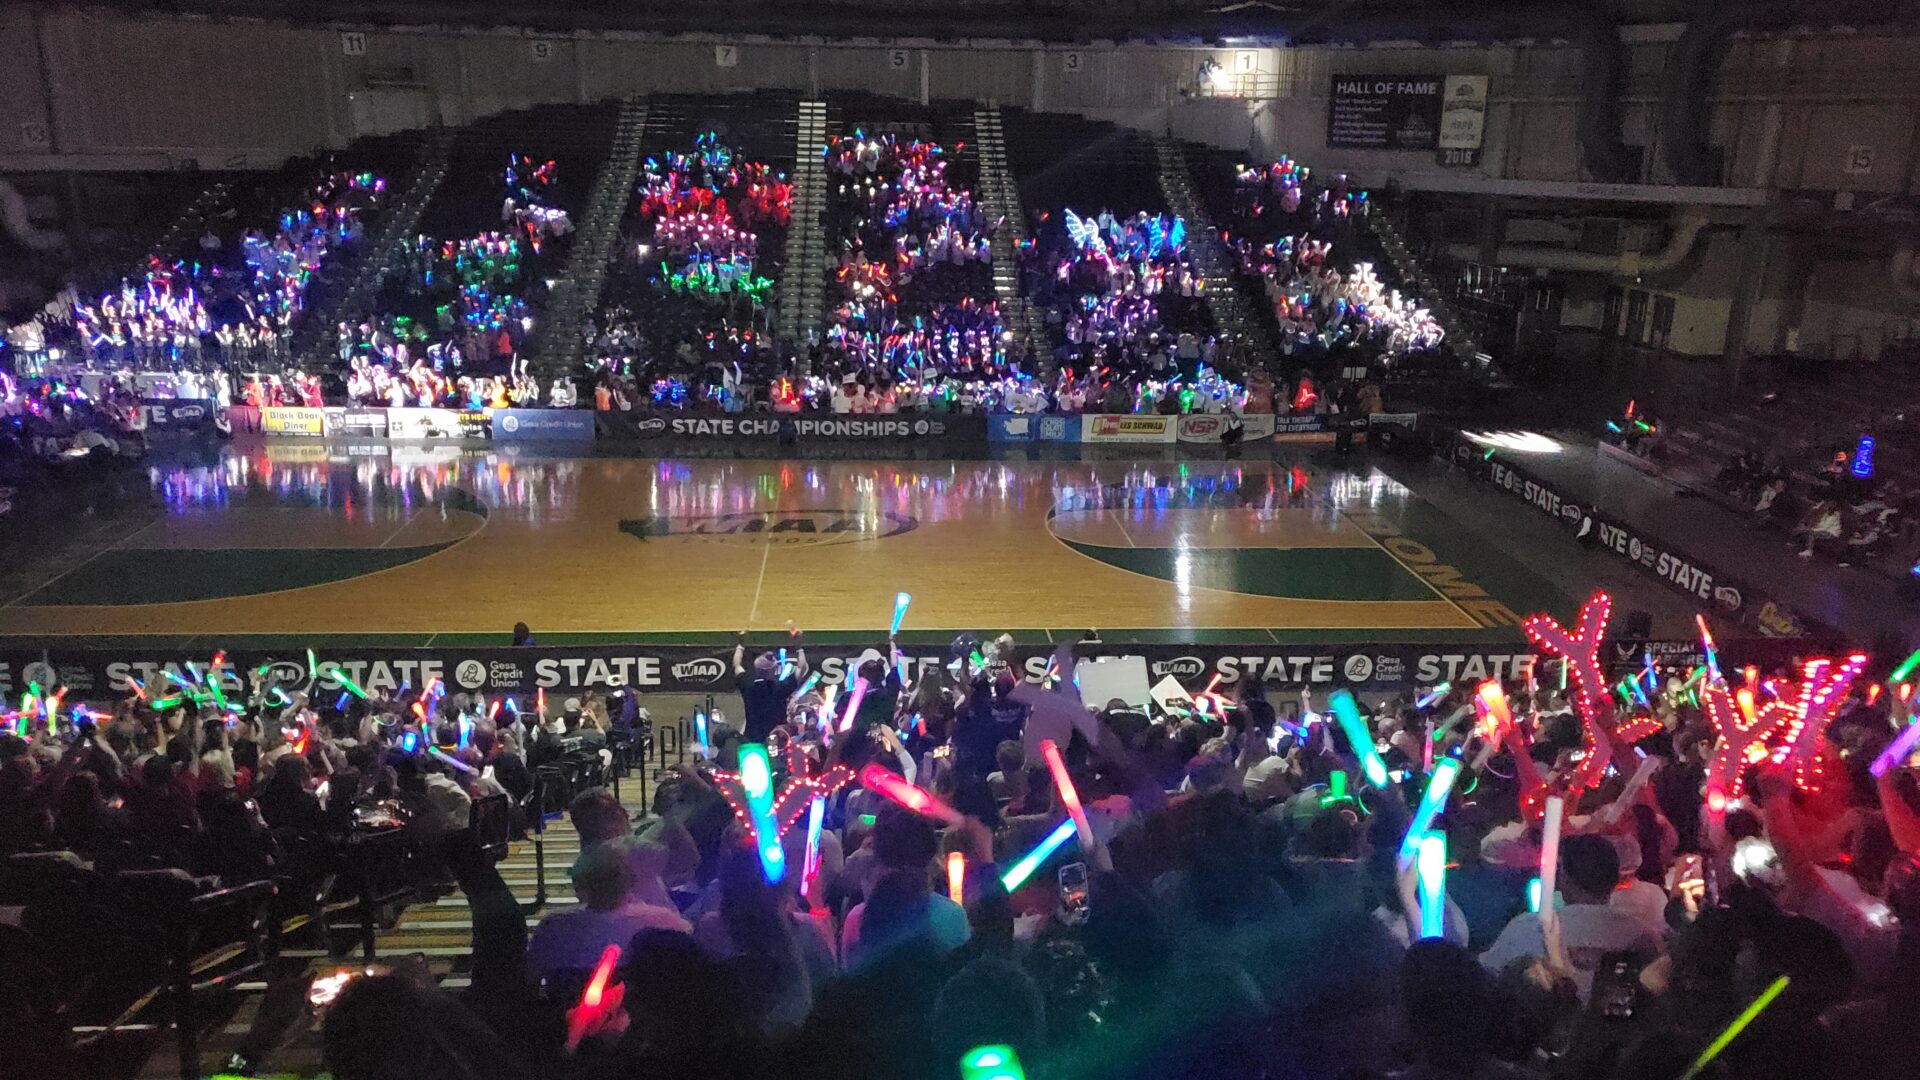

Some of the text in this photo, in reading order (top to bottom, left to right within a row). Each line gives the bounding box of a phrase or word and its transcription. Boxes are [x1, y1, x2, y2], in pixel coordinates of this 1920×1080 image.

[347, 36, 364, 51] 11
[536, 43, 547, 58] 9
[721, 47, 731, 58] 7
[893, 52, 905, 66] 5
[1066, 54, 1078, 68] 3
[1243, 54, 1251, 69] 1
[1337, 82, 1438, 95] HALL OF FAME
[1444, 151, 1473, 164] 2018
[1850, 149, 1871, 168] 15
[270, 411, 319, 419] Black Bear
[284, 421, 308, 430] Diner
[672, 419, 909, 436] STATE CHAPIONSHIPS
[1133, 421, 1164, 430] SCHWAB
[1184, 421, 1218, 433] NSP
[1524, 480, 1561, 517] STATE
[1656, 551, 1713, 600] STATE
[490, 660, 516, 670] Gesa
[1377, 655, 1401, 664] Gesa
[490, 669, 524, 679] Credit
[535, 657, 661, 687] STATE
[680, 664, 718, 676] WIAA
[1160, 663, 1196, 674] WIAA
[1216, 656, 1334, 684] STATE
[1376, 663, 1406, 674] Credit
[1415, 654, 1535, 682] STATE
[318, 660, 444, 690] STATE
[1375, 672, 1402, 682] Union
[491, 678, 520, 688] Union
